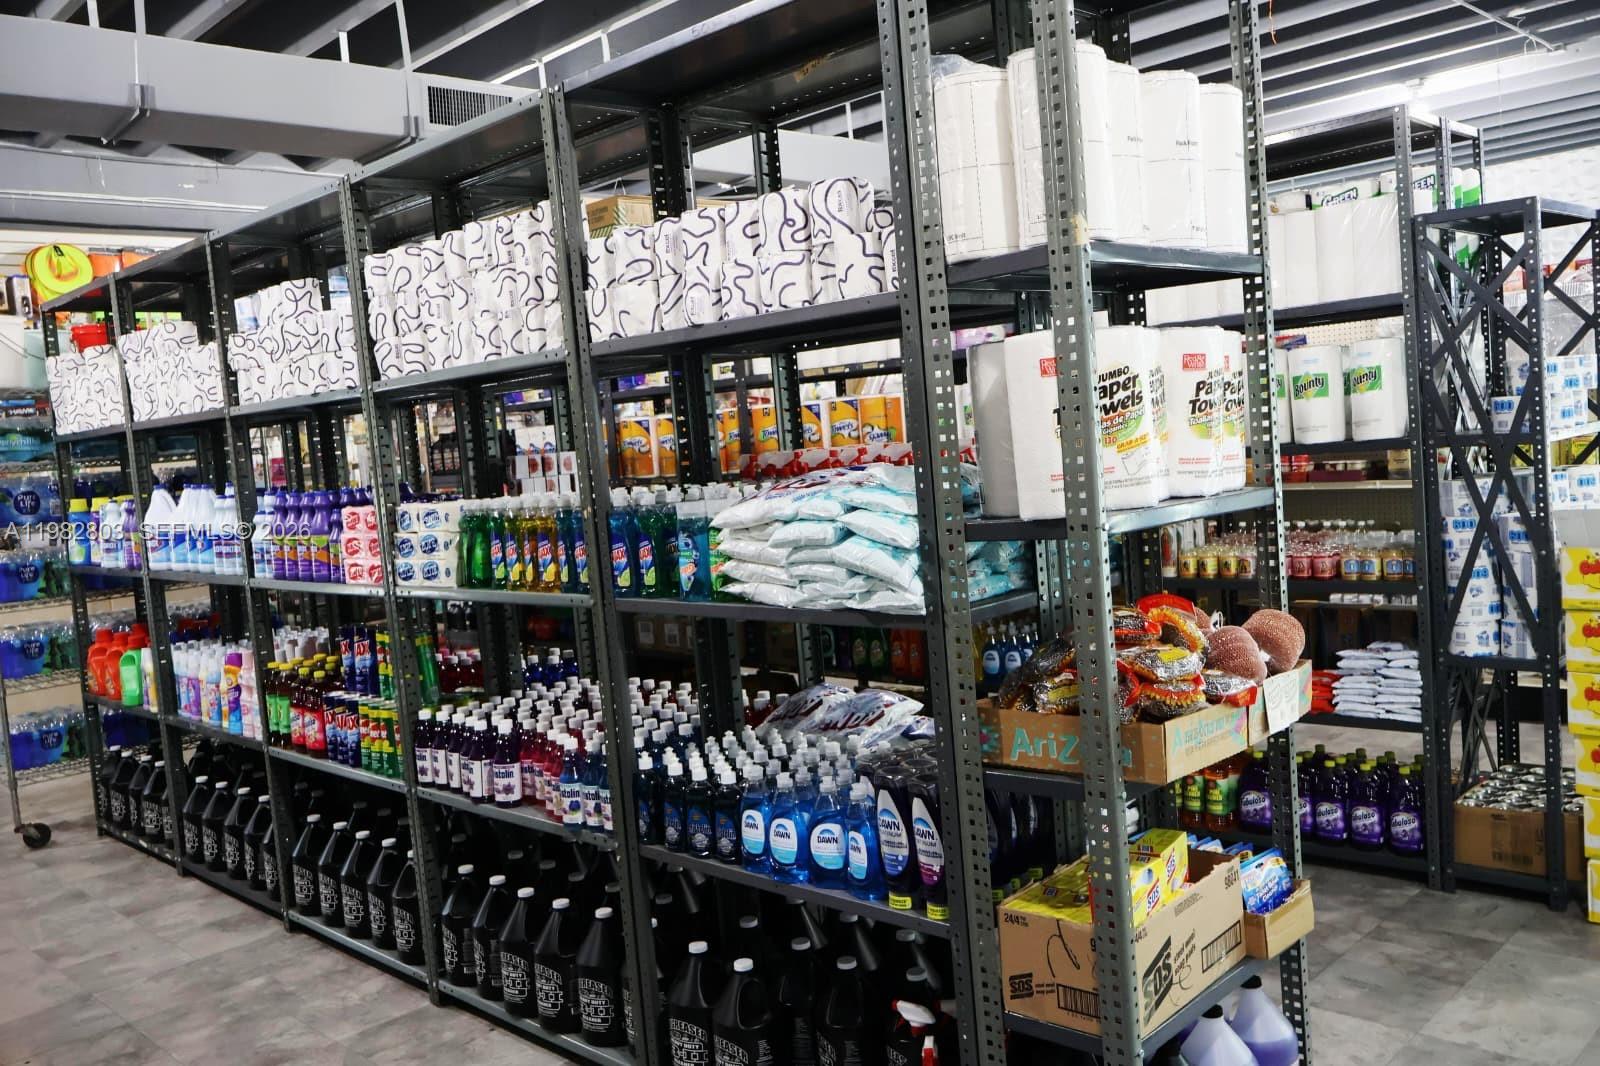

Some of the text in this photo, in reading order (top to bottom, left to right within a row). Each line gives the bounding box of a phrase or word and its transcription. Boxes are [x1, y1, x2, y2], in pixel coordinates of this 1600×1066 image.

[1098, 366, 1129, 384] JUMBO
[1098, 373, 1139, 400] aper
[1295, 377, 1324, 397] Bounty
[1100, 390, 1143, 416] wels
[495, 770, 514, 779] stolin
[561, 788, 580, 798] stolin
[774, 829, 791, 840] DAWN
[817, 835, 838, 845] DAWN
[1010, 979, 1034, 994] SOS
